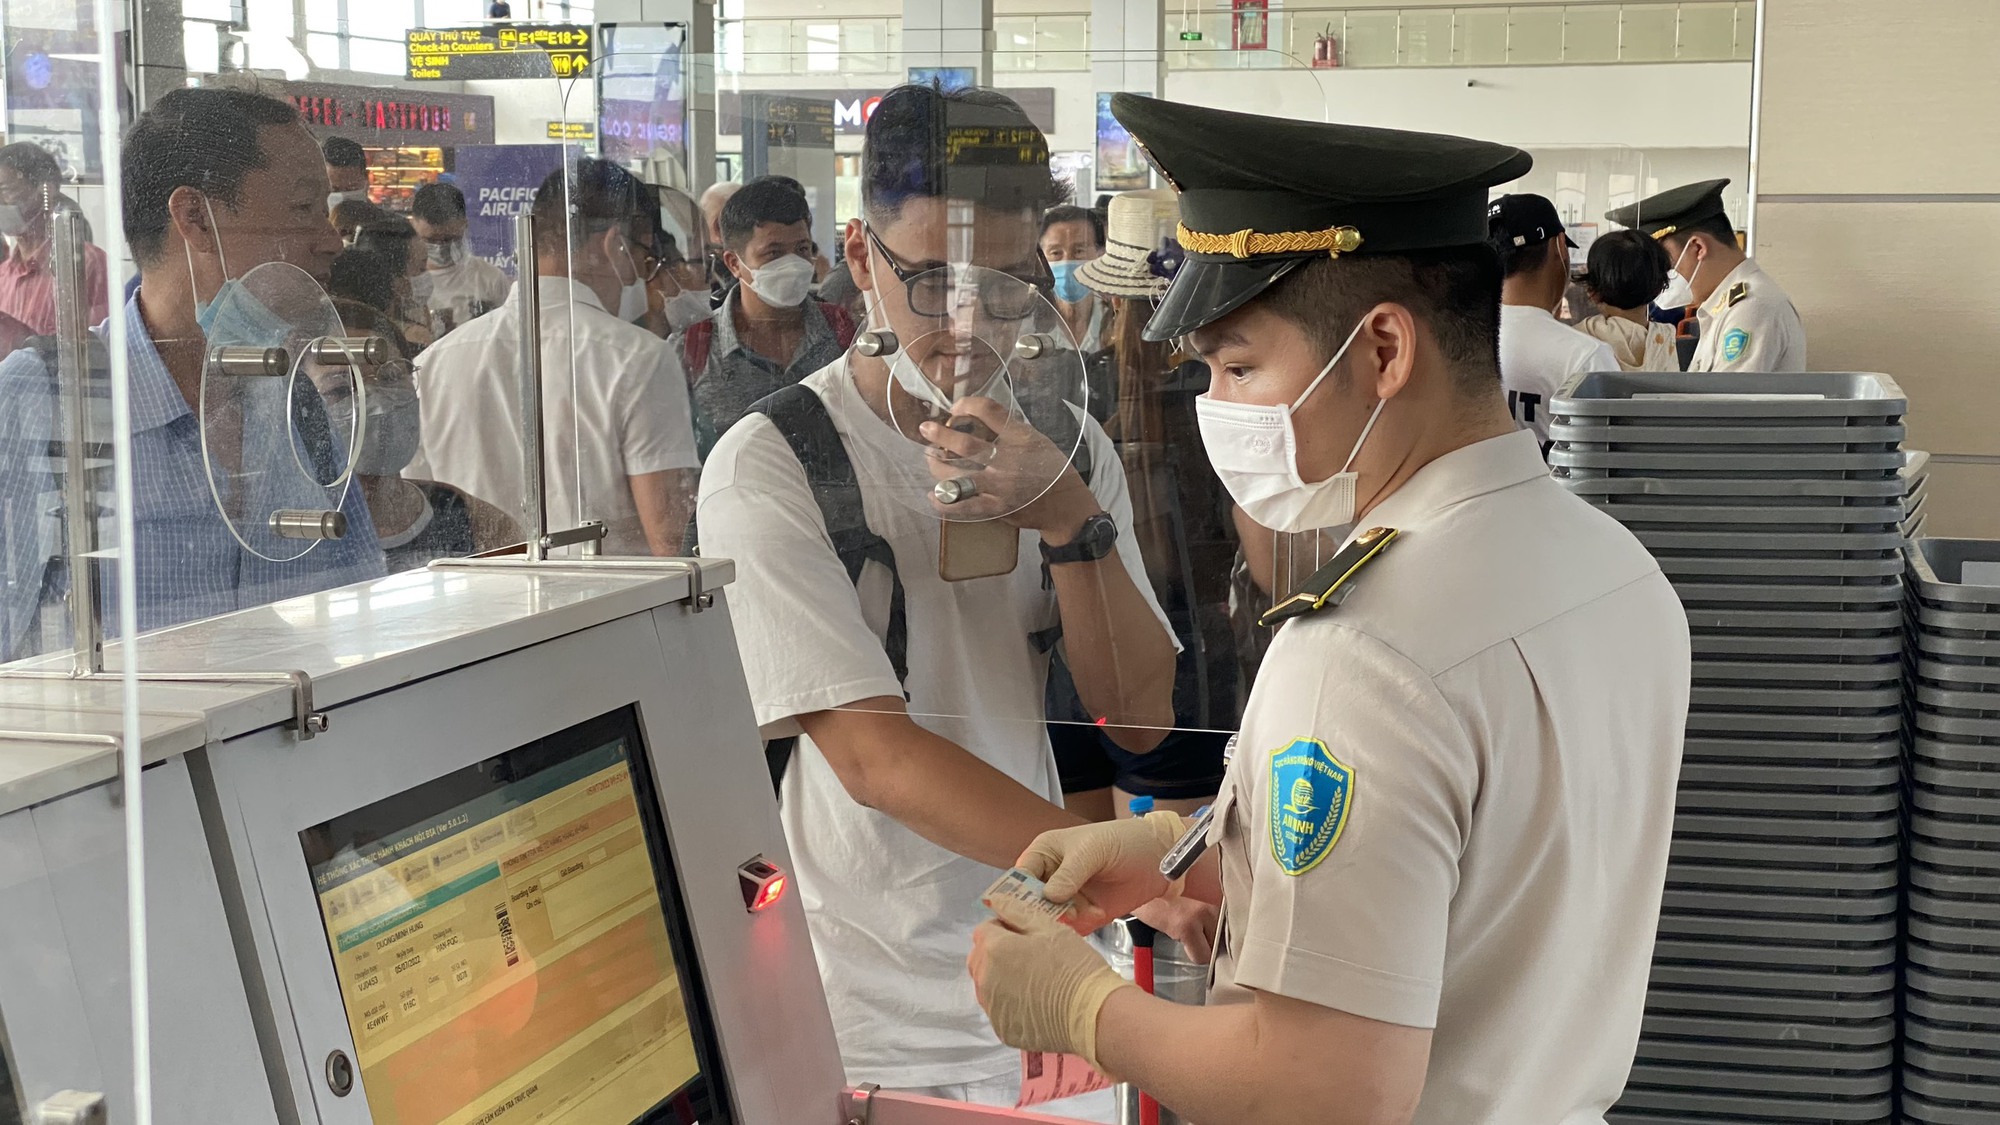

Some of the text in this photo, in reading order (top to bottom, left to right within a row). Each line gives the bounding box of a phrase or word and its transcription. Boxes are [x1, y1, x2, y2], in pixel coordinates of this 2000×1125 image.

[548, 32, 571, 45] E18
[410, 42, 494, 52] Check-in Counters
[425, 56, 449, 66] SINH
[411, 69, 441, 78] Toilets
[479, 187, 539, 201] PACIFIC
[480, 202, 534, 216] AIRLIN
[1326, 767, 1344, 783] NAM
